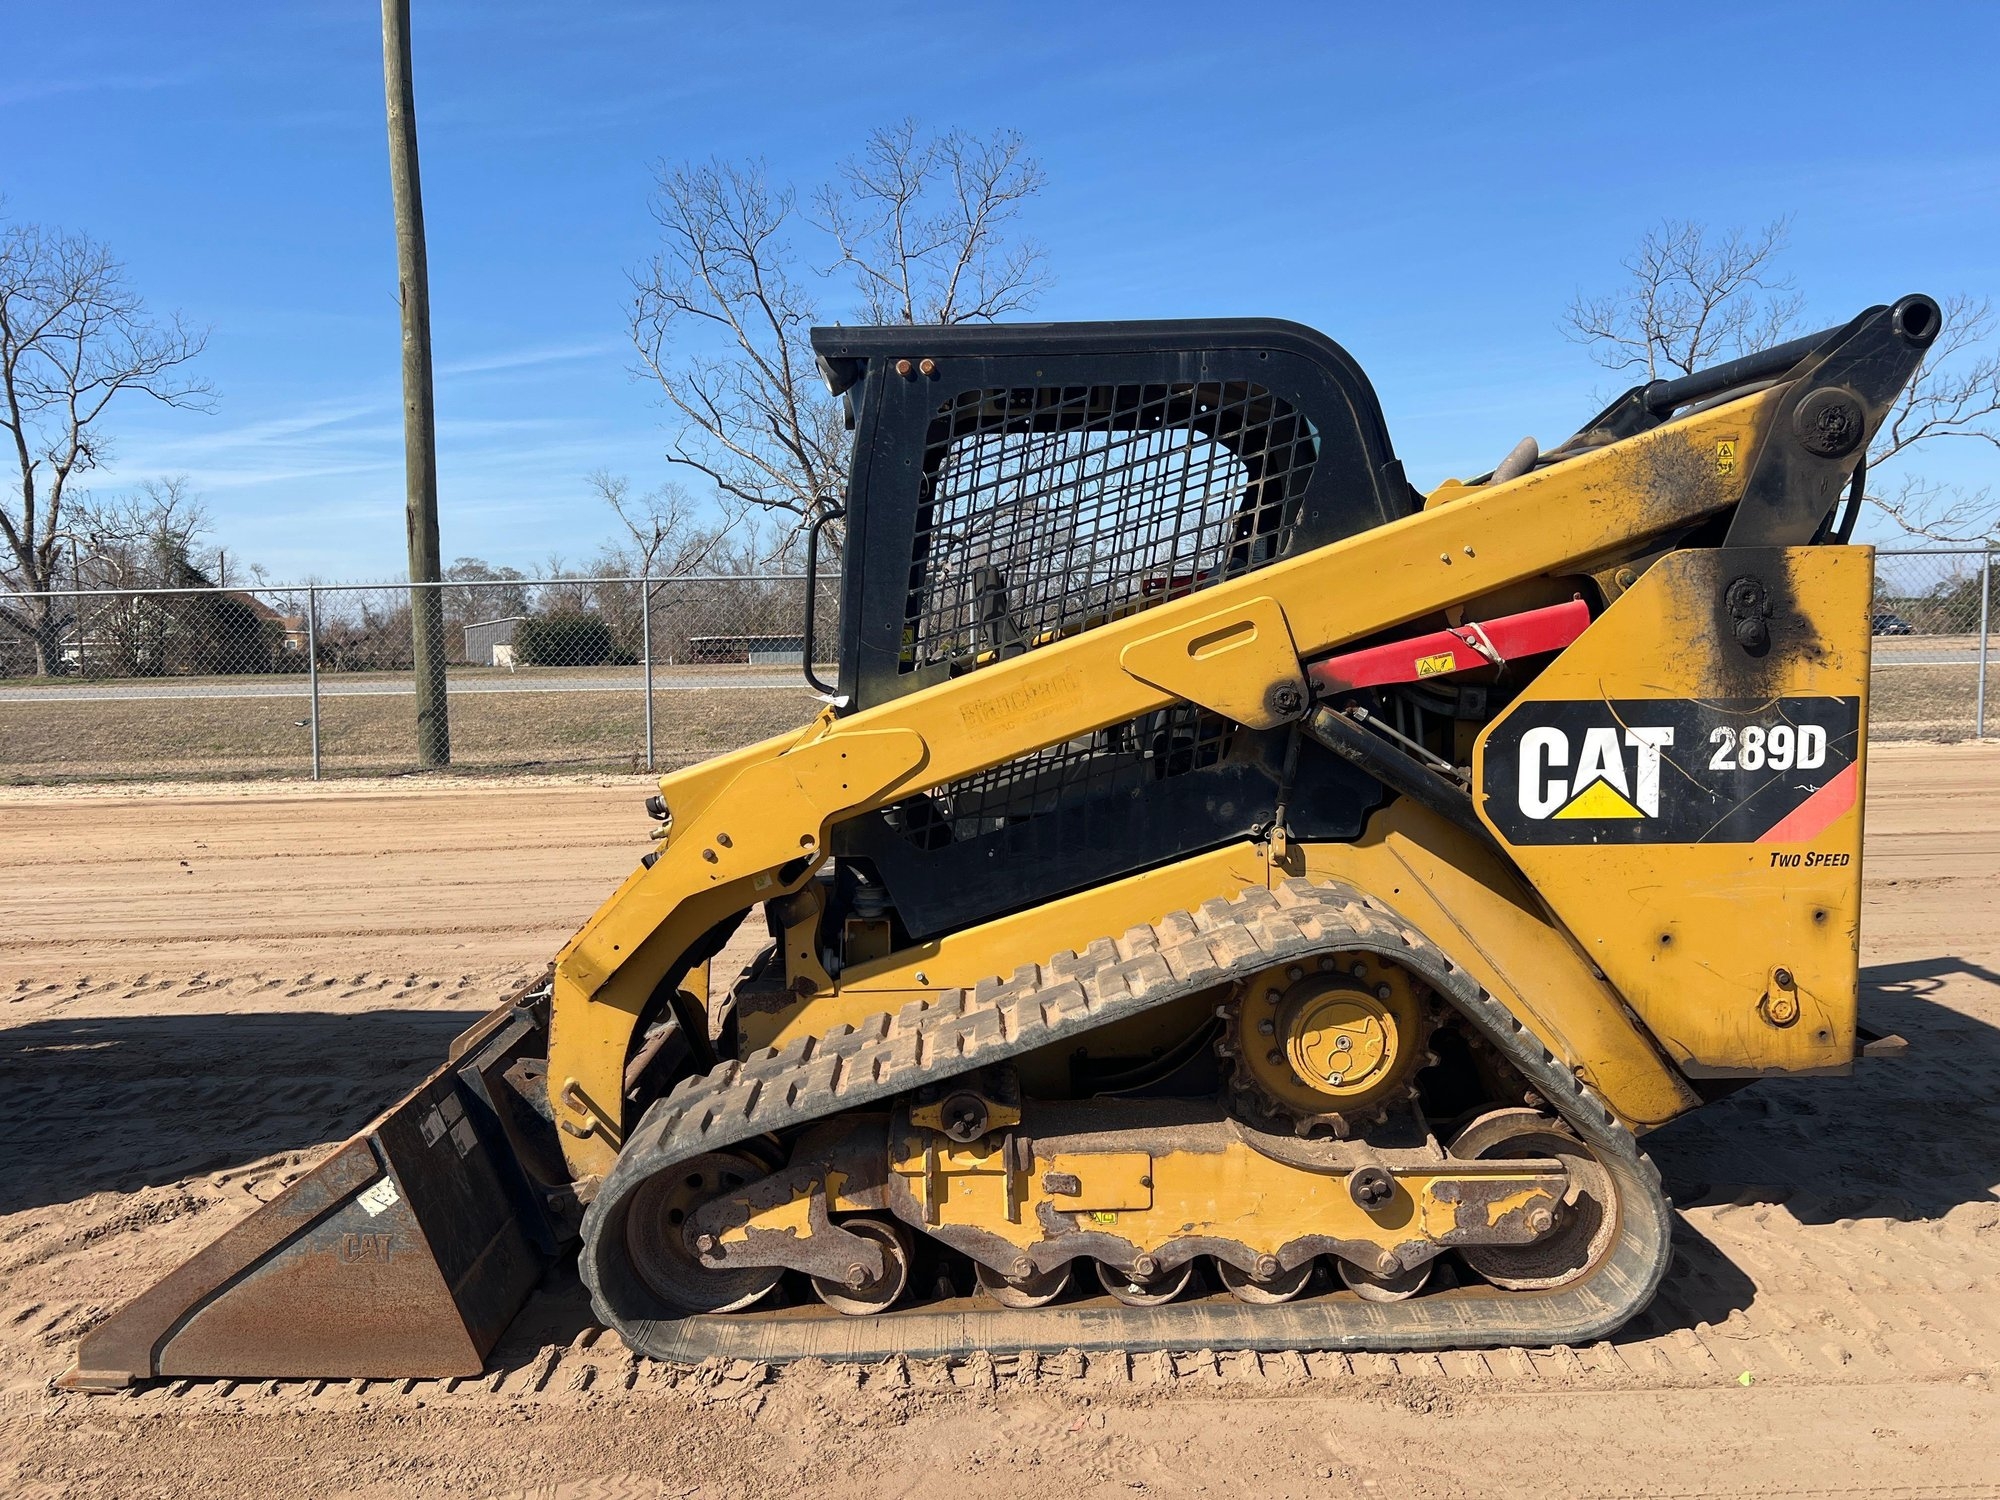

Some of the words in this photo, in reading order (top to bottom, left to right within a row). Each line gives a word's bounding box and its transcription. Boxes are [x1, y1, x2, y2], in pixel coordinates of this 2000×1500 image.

[1709, 725, 1827, 771] 289D
[1518, 726, 1674, 820] CAT
[342, 1233, 393, 1263] CAT
